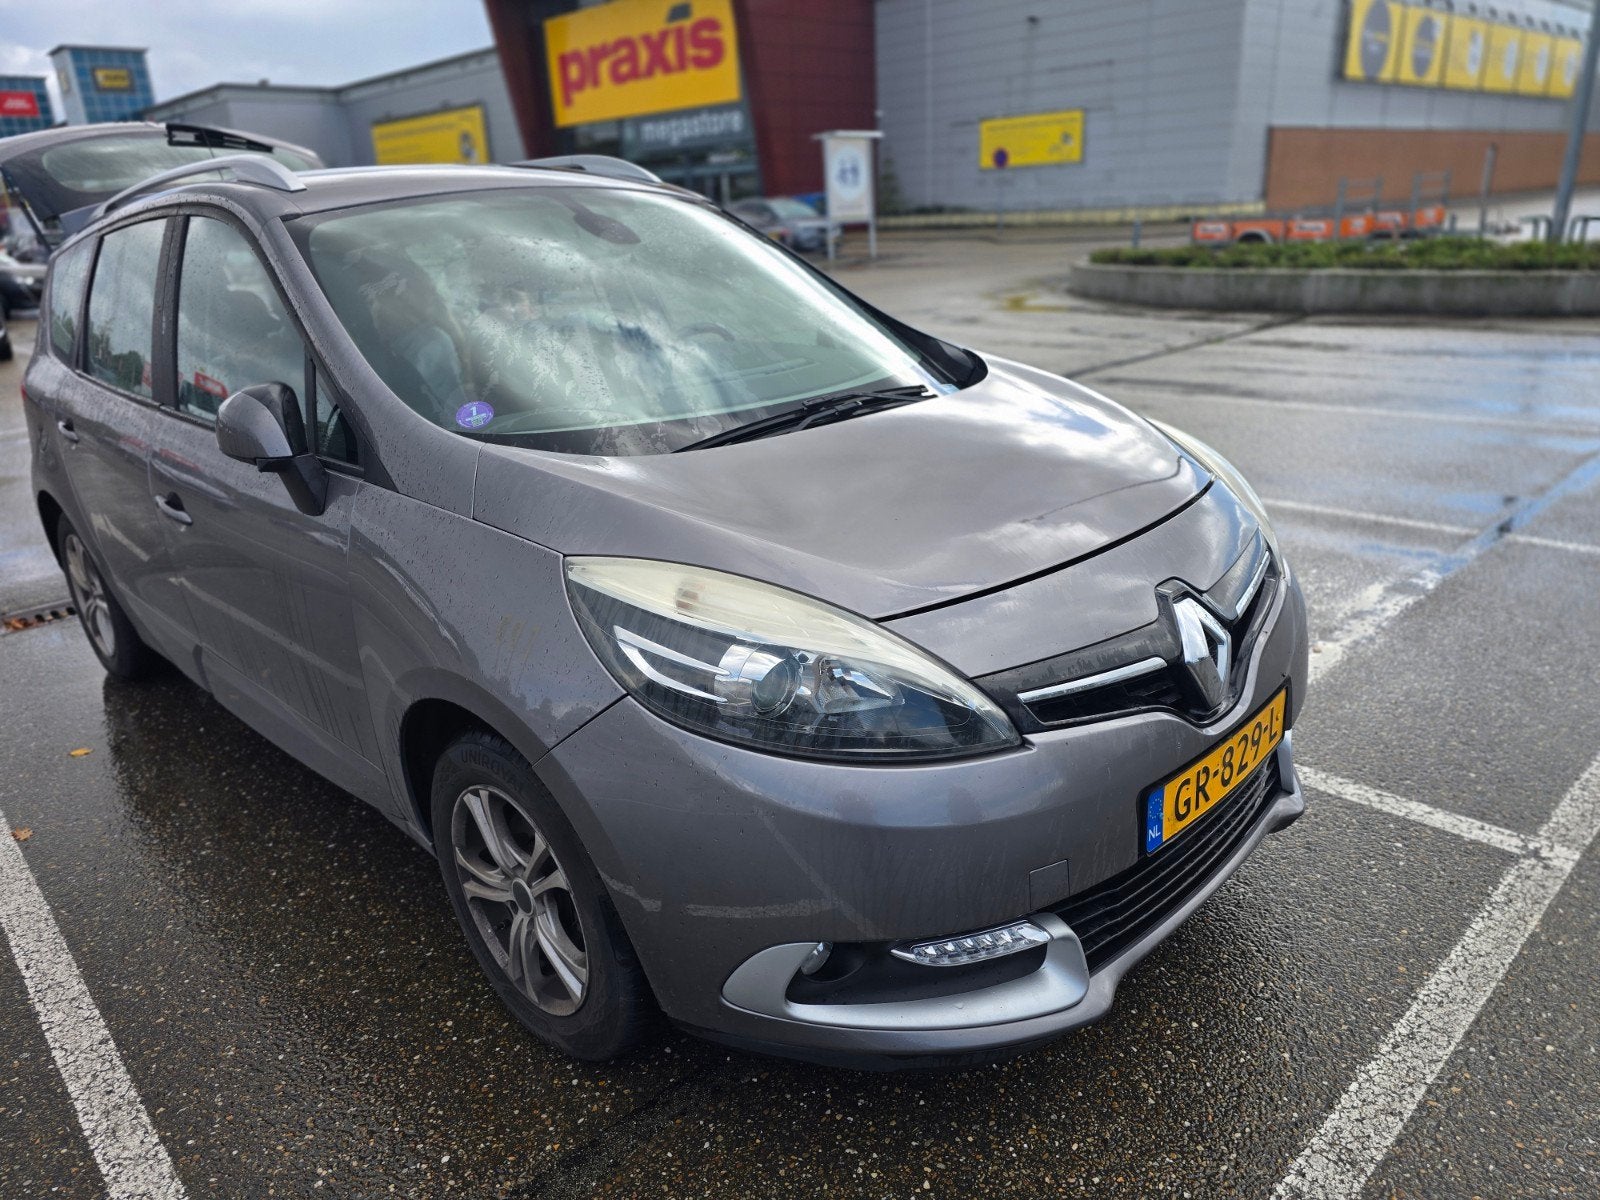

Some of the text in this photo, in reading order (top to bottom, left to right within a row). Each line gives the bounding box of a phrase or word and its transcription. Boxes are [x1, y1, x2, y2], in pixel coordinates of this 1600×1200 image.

[559, 5, 725, 106] praxis
[1173, 706, 1278, 822] GR-829-L
[1148, 824, 1161, 842] NL
